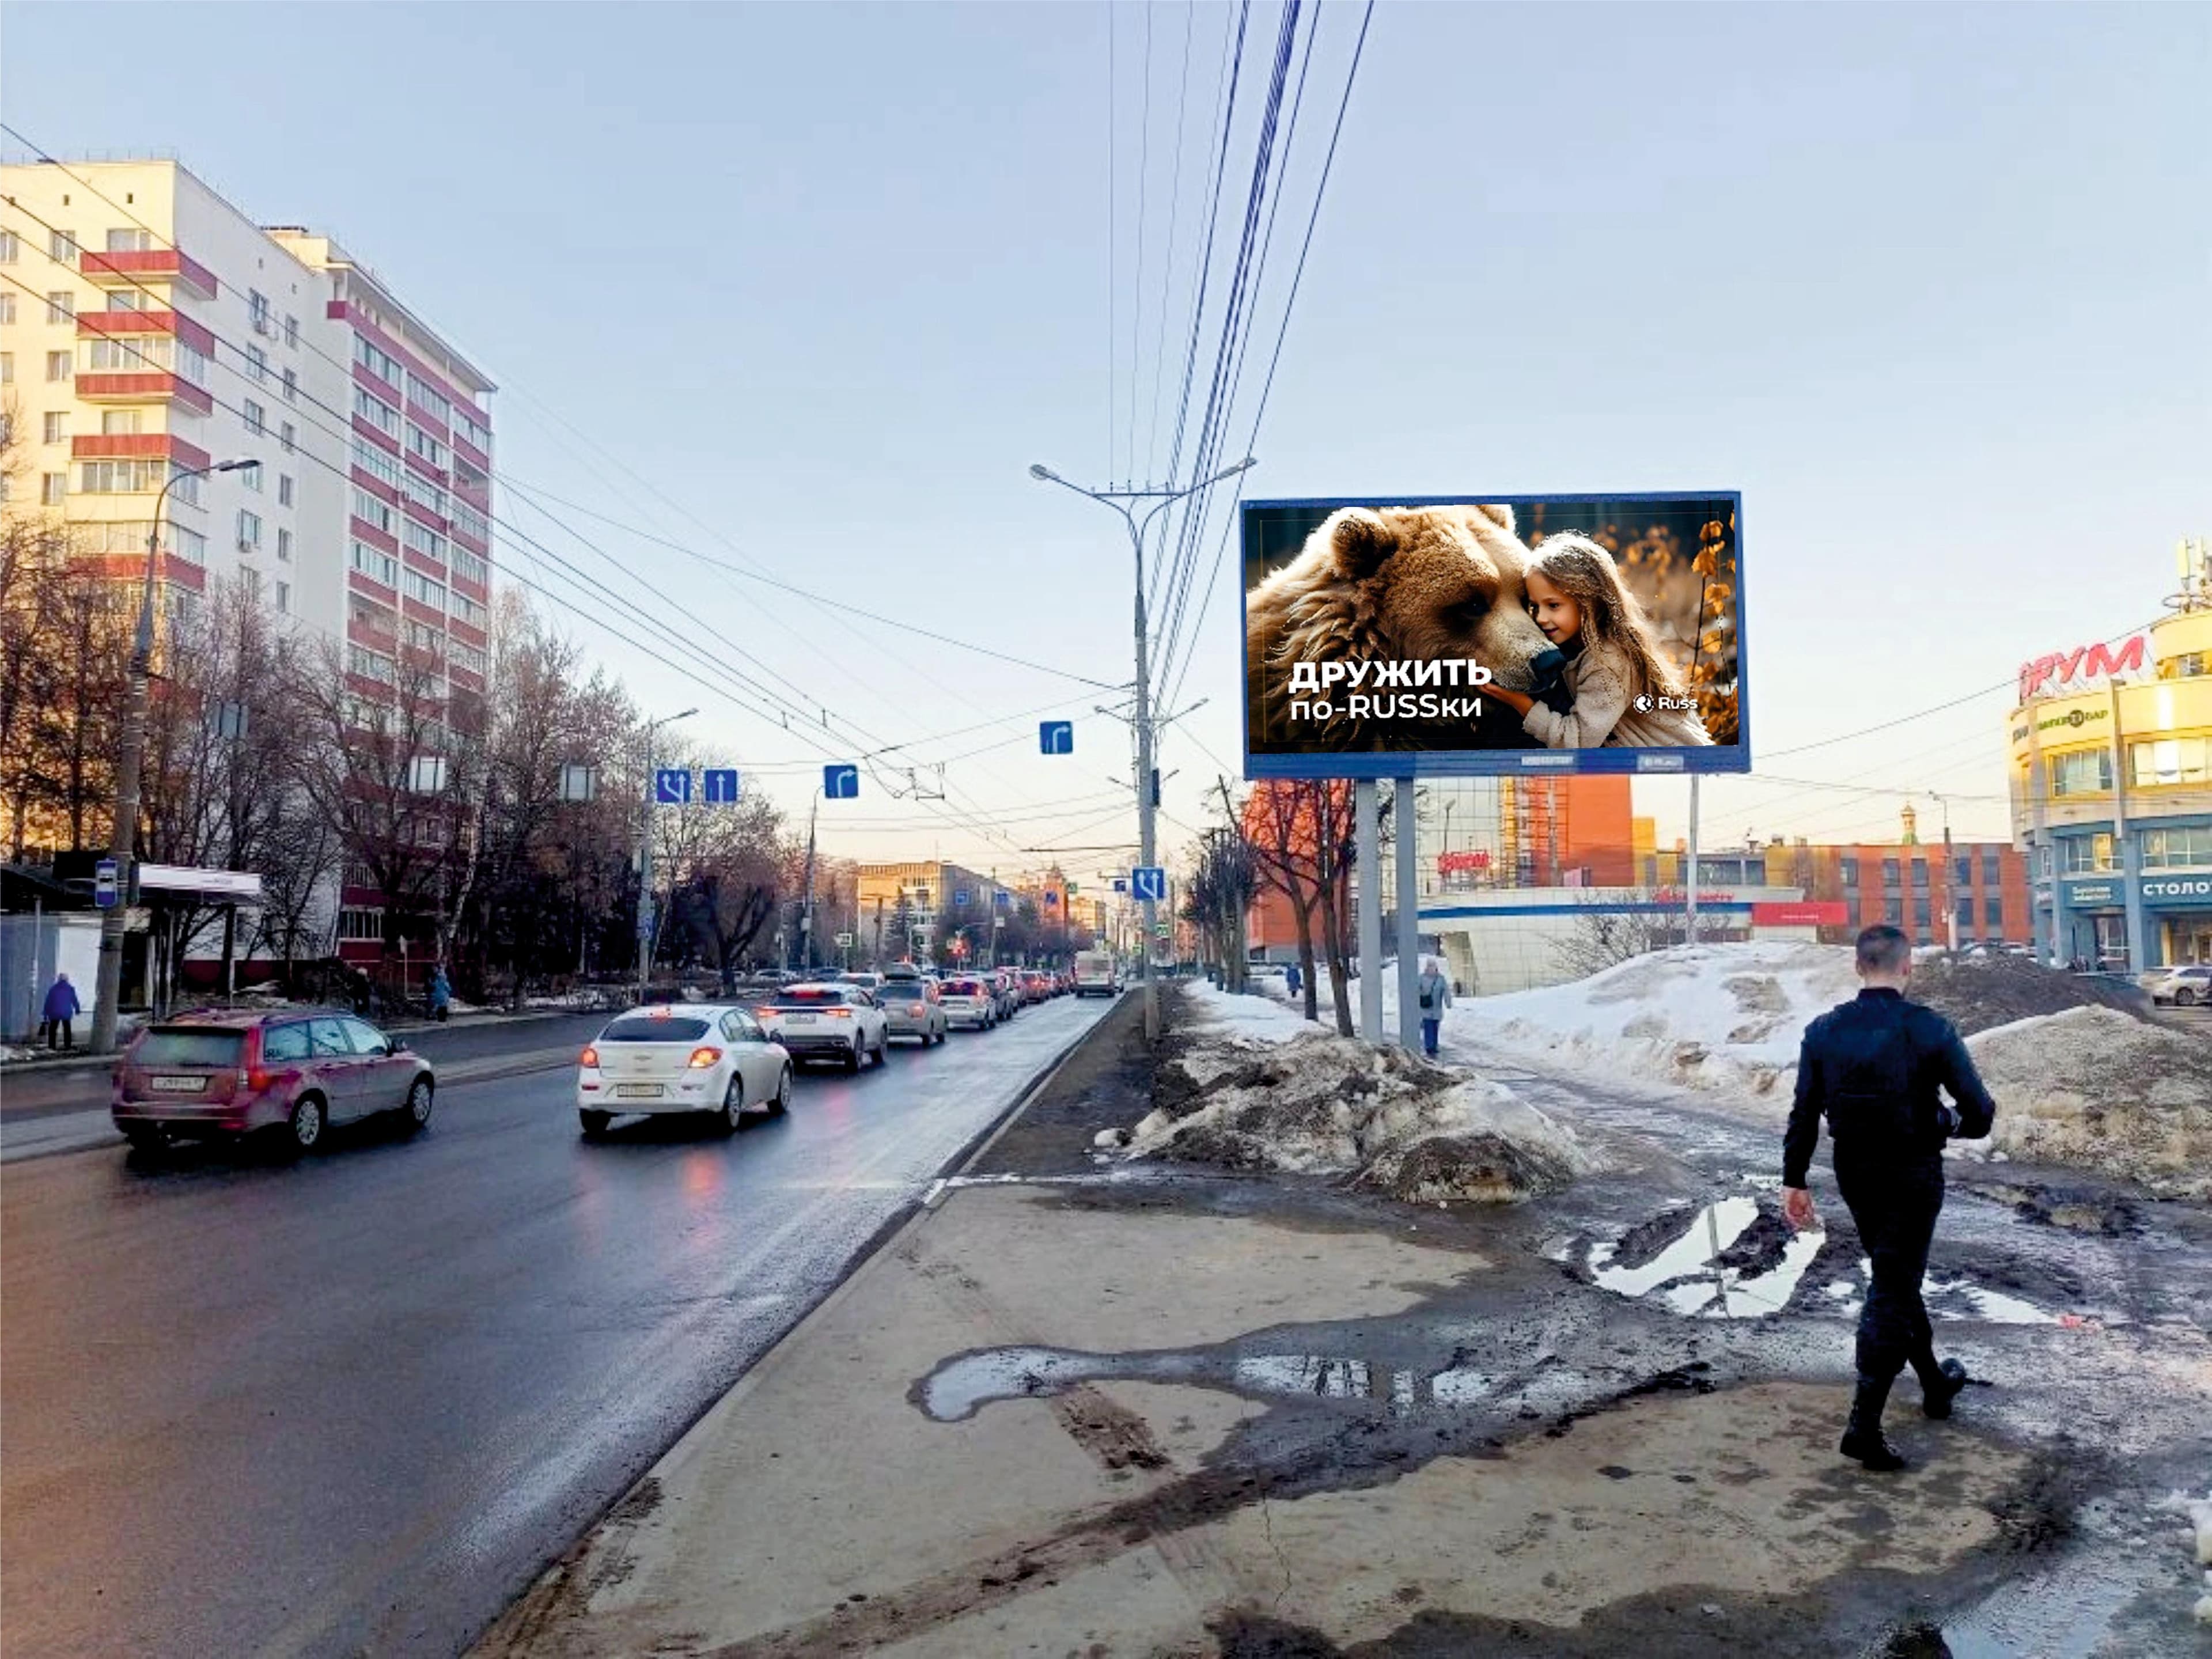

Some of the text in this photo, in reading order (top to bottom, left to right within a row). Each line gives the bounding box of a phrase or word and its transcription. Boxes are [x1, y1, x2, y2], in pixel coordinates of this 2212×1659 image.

[1288, 659, 1493, 694] ДРУЖИТЬ
[1291, 694, 1482, 720] по-RUSSки
[1658, 696, 1698, 710] Russ
